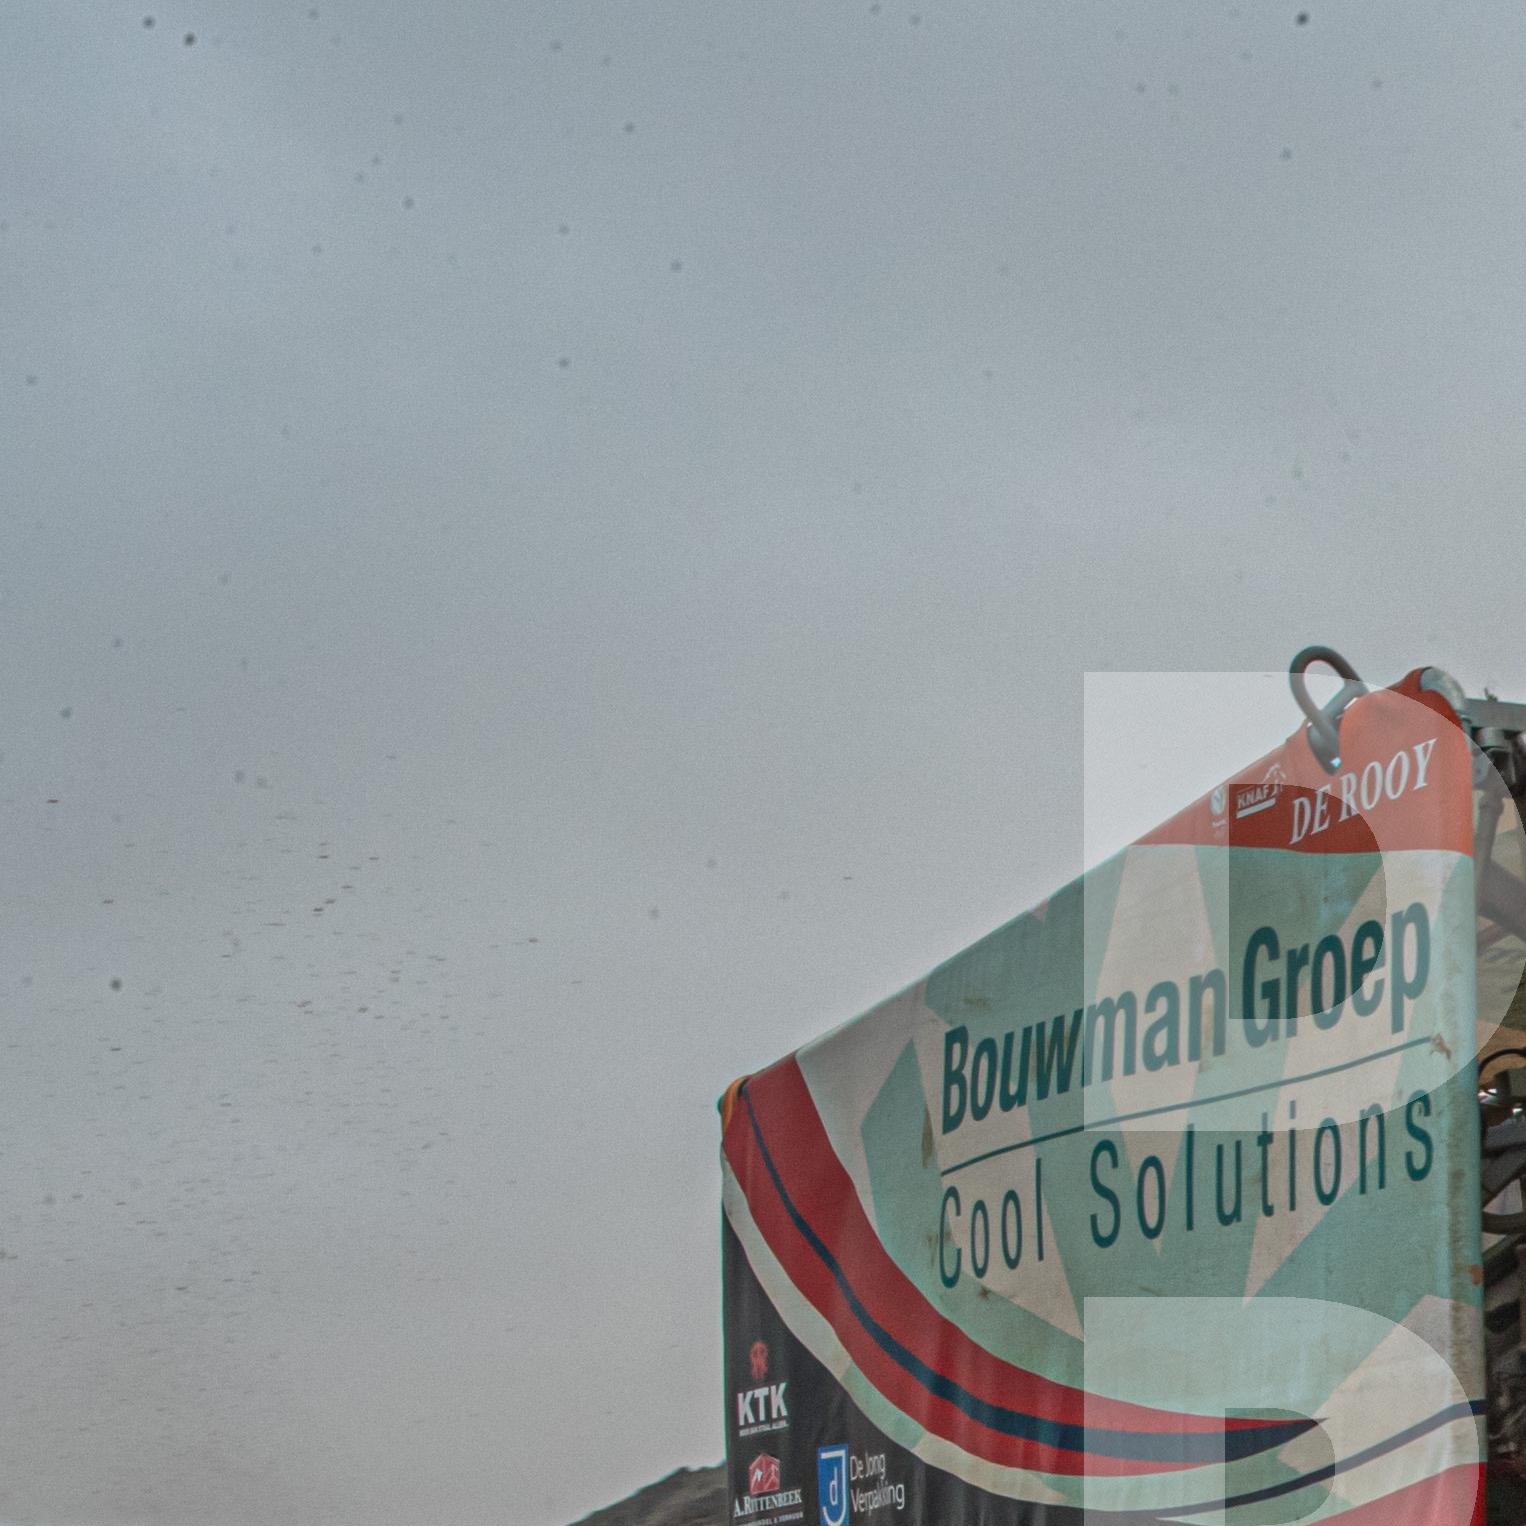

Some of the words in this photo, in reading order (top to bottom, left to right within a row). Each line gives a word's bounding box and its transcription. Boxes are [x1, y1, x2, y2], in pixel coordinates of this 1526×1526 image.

[1290, 784, 1333, 845] DE
[1339, 738, 1438, 823] ROOY
[942, 968, 1227, 1135] Bouwman
[1242, 902, 1431, 1048] Groep
[938, 1158, 1044, 1289] Cool
[1089, 1089, 1434, 1249] Solutions
[737, 1382, 788, 1426] KTK
[850, 1455, 864, 1481] De
